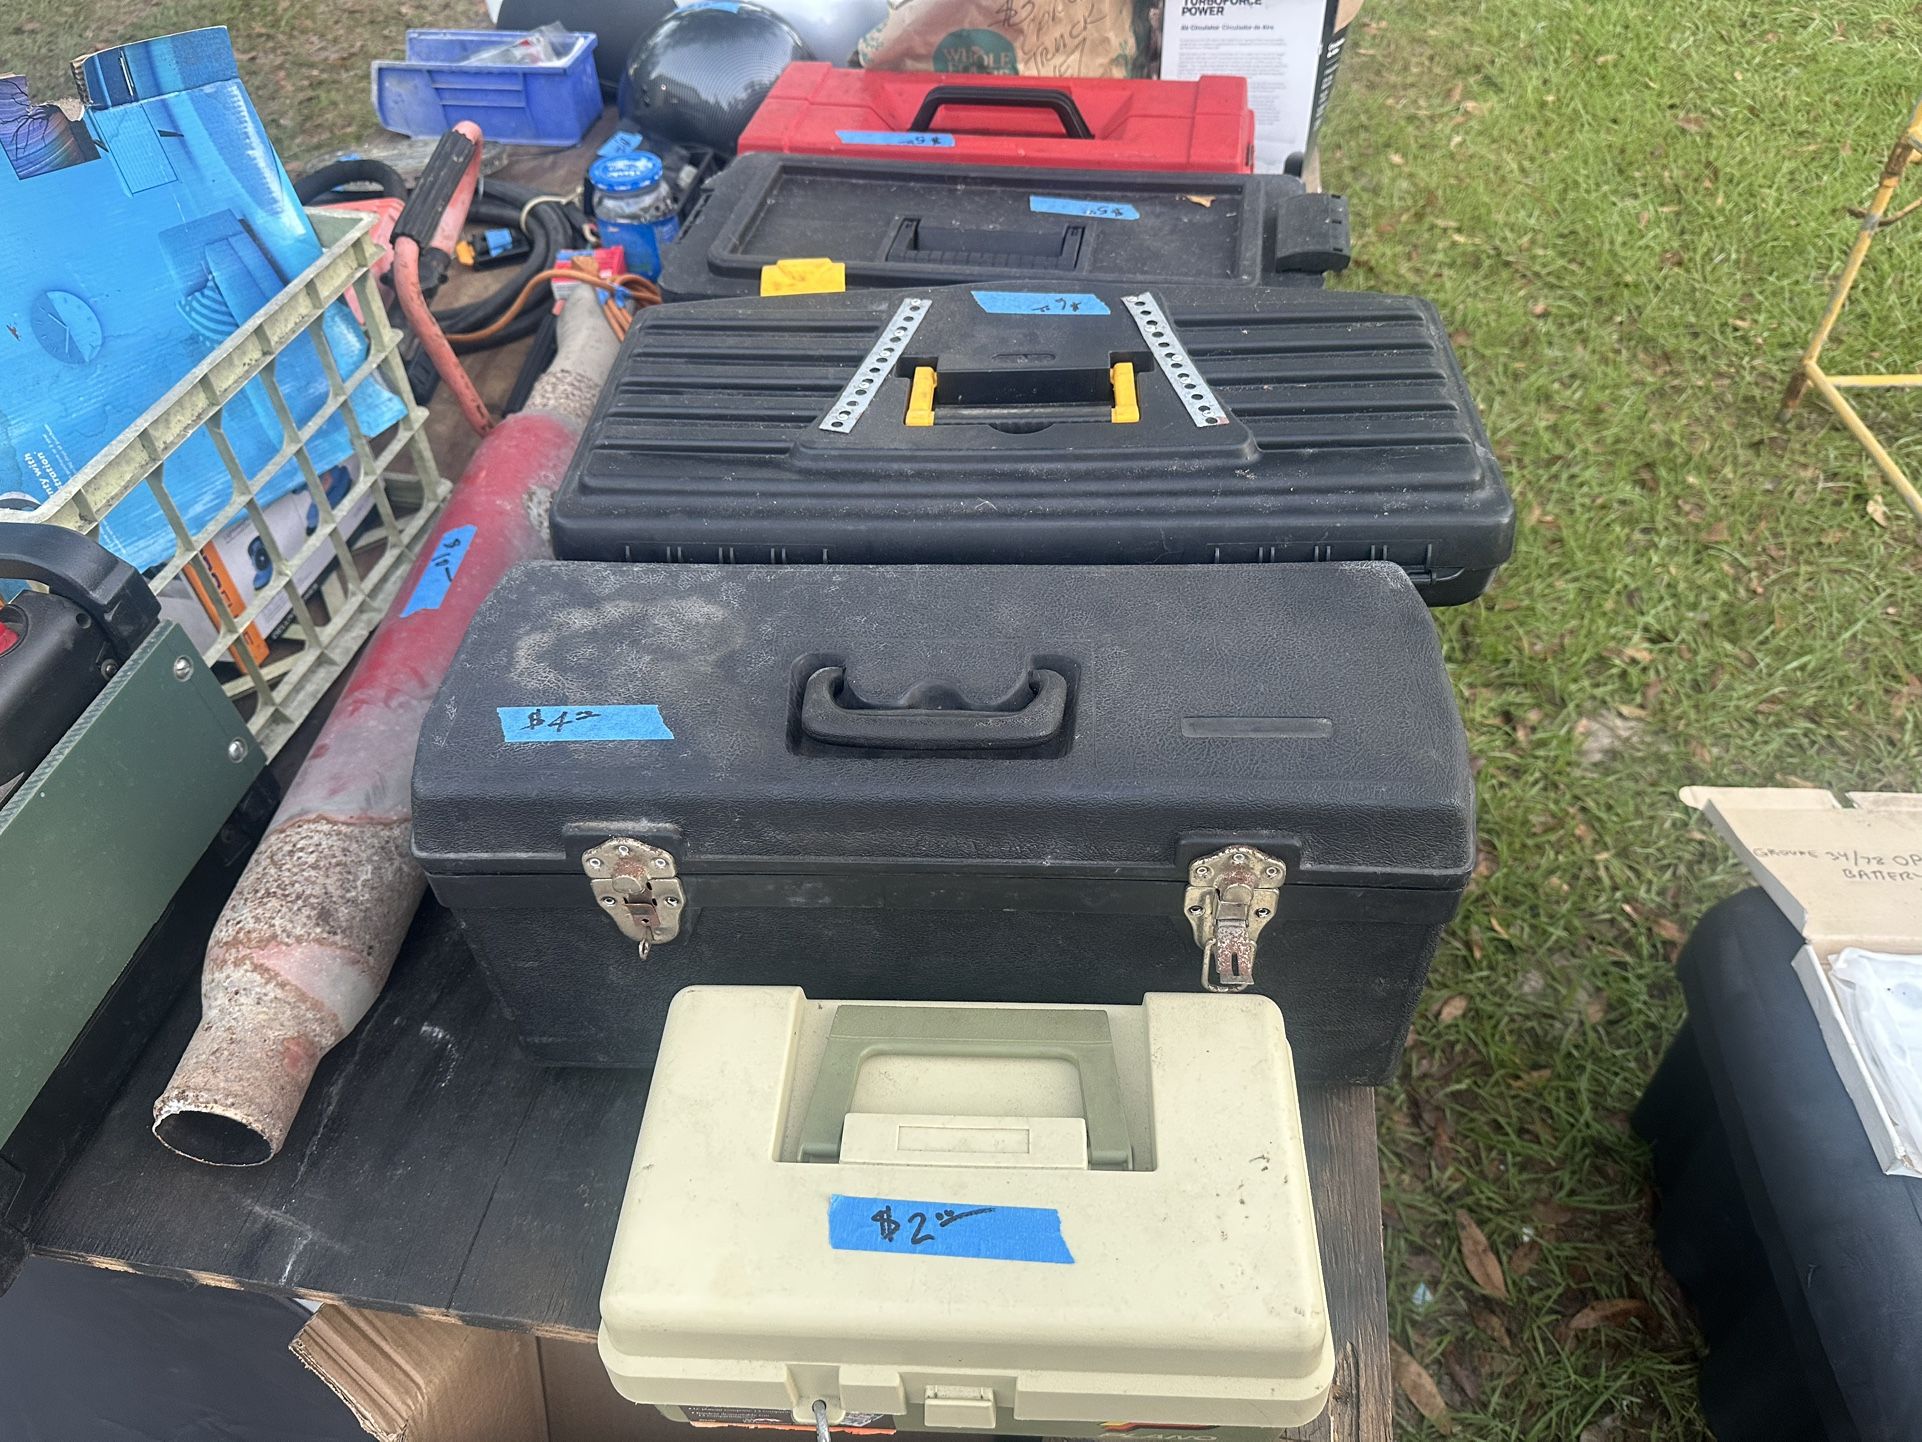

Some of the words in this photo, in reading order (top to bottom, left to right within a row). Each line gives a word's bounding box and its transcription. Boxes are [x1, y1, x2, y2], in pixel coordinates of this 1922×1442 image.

[1181, 6, 1225, 17] POWER
[24, 453, 41, 477] with
[36, 451, 62, 489] tration
